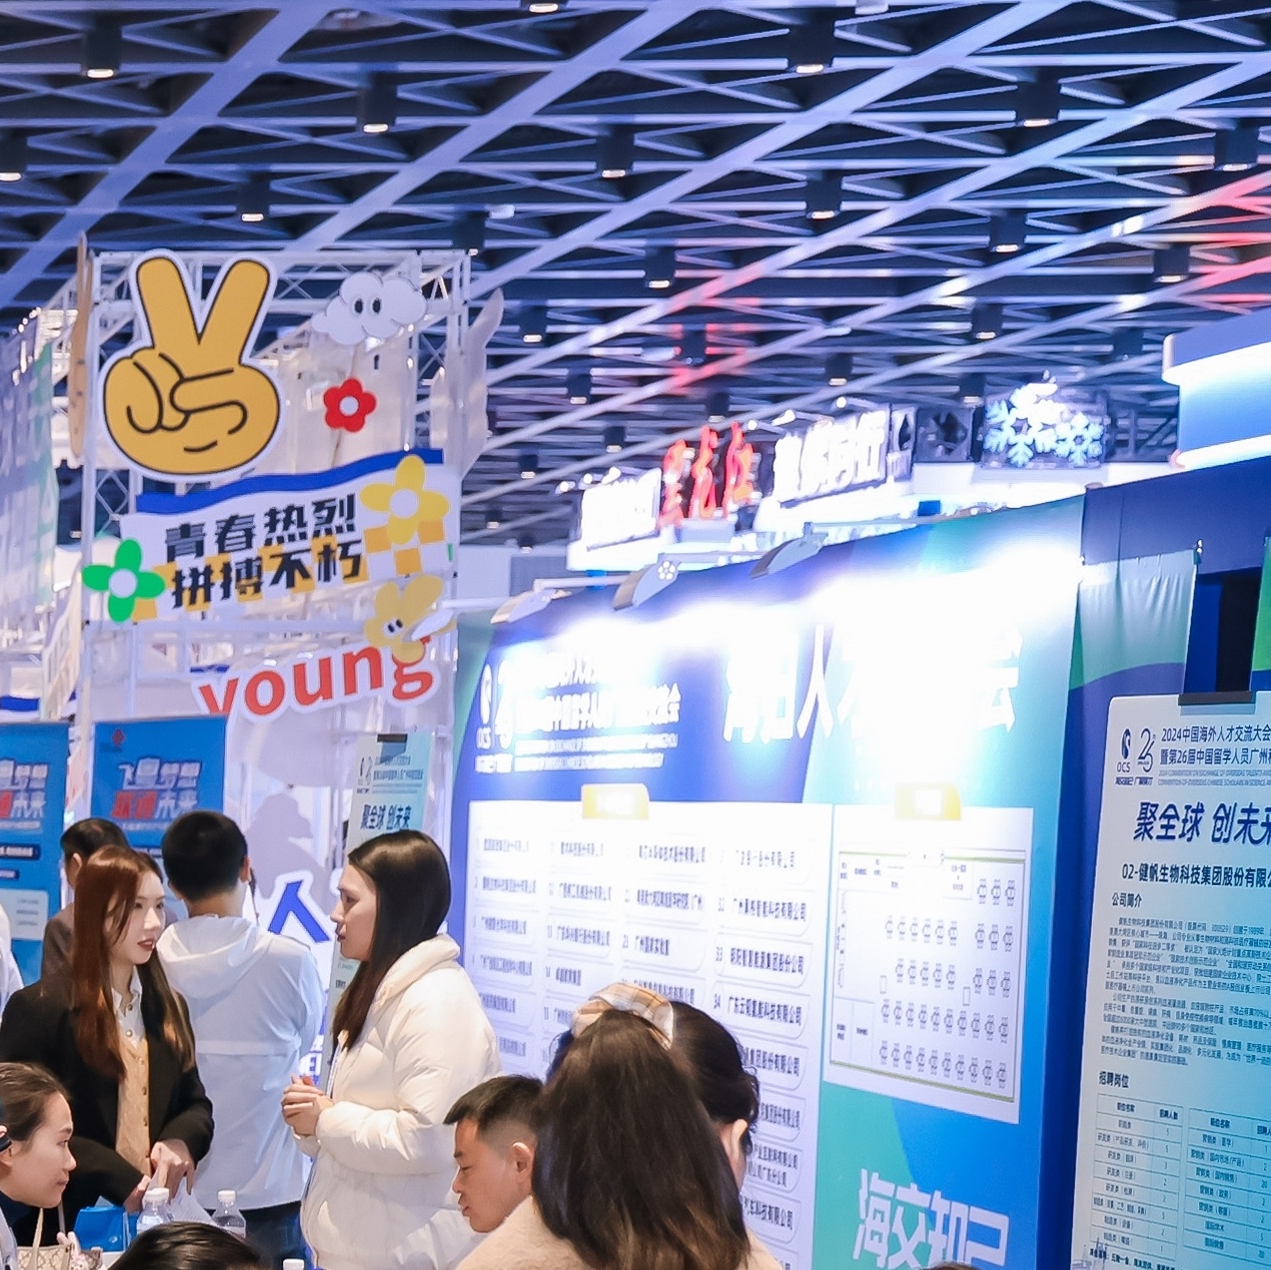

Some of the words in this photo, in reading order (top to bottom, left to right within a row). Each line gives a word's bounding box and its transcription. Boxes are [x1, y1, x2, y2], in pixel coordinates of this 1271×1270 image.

[164, 492, 357, 564] 青春热烈
[170, 540, 364, 610] 拼搏不朽
[200, 637, 435, 716] young
[1117, 761, 1131, 773] OCS
[1133, 801, 1205, 843] 聚全球
[1112, 892, 1142, 908] 公司简介
[1098, 1071, 1130, 1088] 招聘岗位
[852, 1168, 1010, 1270] 海交知己
